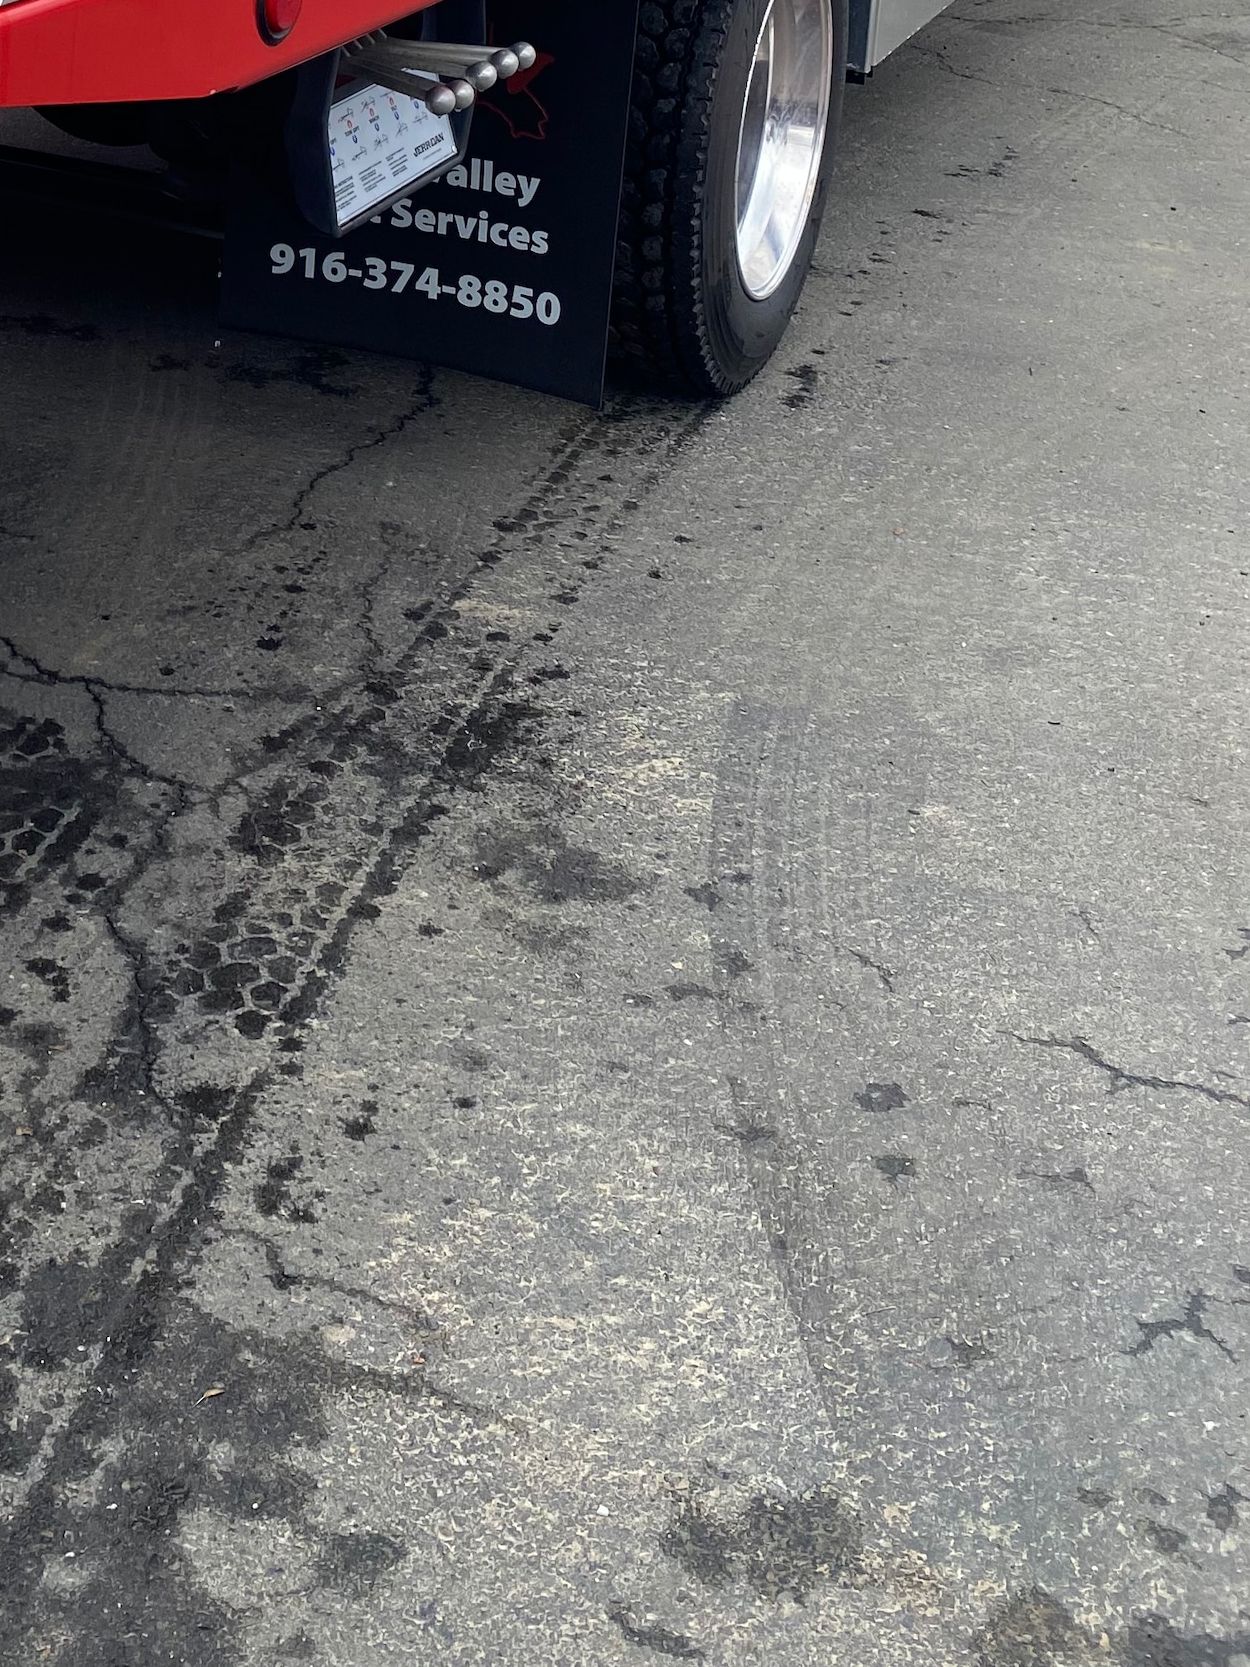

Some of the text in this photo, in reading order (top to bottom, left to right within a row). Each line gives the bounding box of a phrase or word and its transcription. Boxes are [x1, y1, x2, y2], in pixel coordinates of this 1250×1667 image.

[434, 158, 541, 207] alley
[390, 199, 549, 255] Services
[269, 243, 562, 326] 916-374-8850
